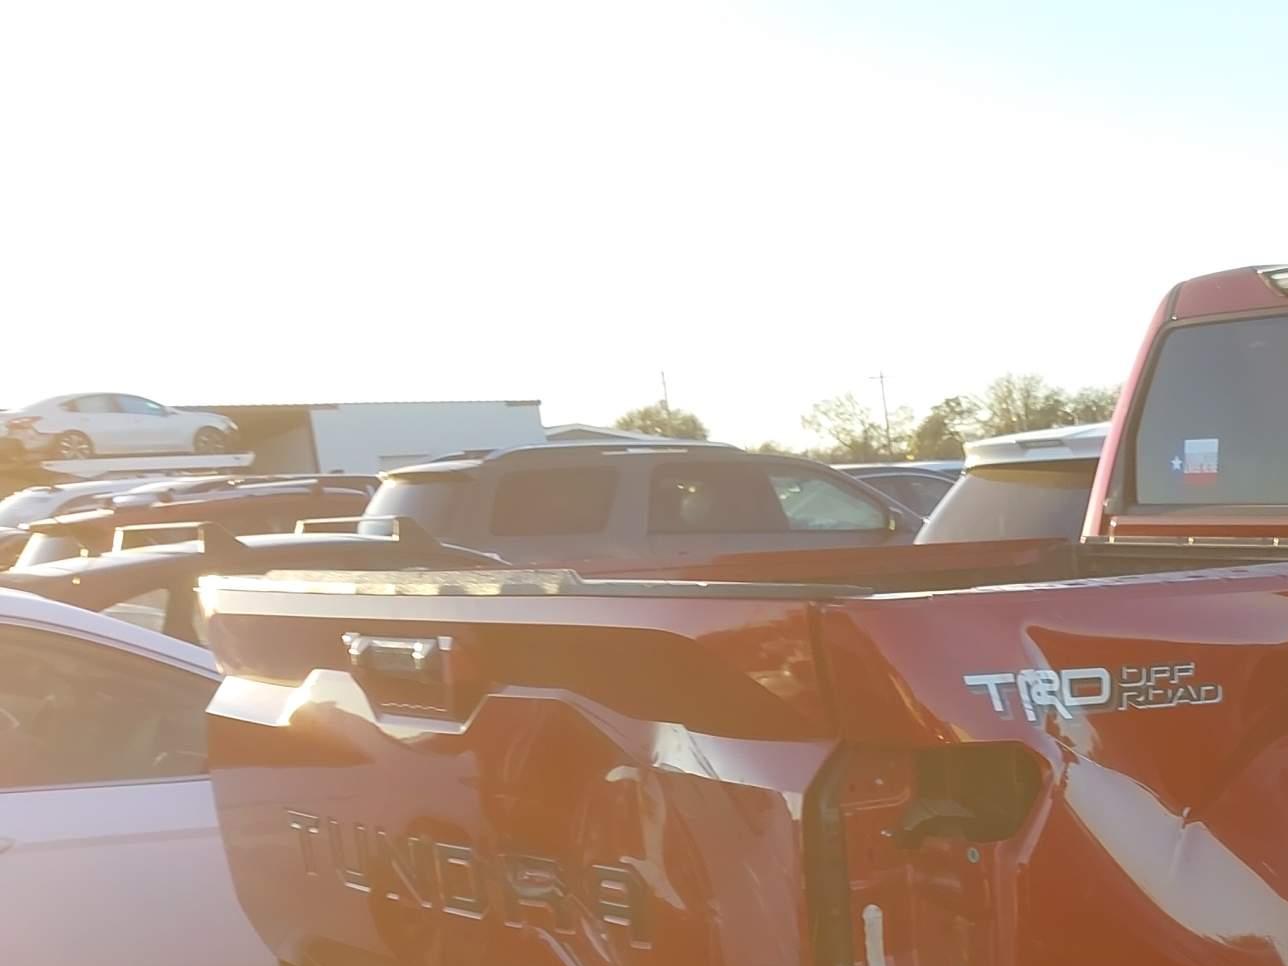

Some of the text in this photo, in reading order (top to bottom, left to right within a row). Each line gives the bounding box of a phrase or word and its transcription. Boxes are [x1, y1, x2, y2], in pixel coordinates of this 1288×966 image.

[963, 667, 1112, 722] TRD
[1119, 662, 1196, 688] OFF
[1117, 684, 1223, 711] ROAD
[286, 808, 653, 951] TUNDRA
